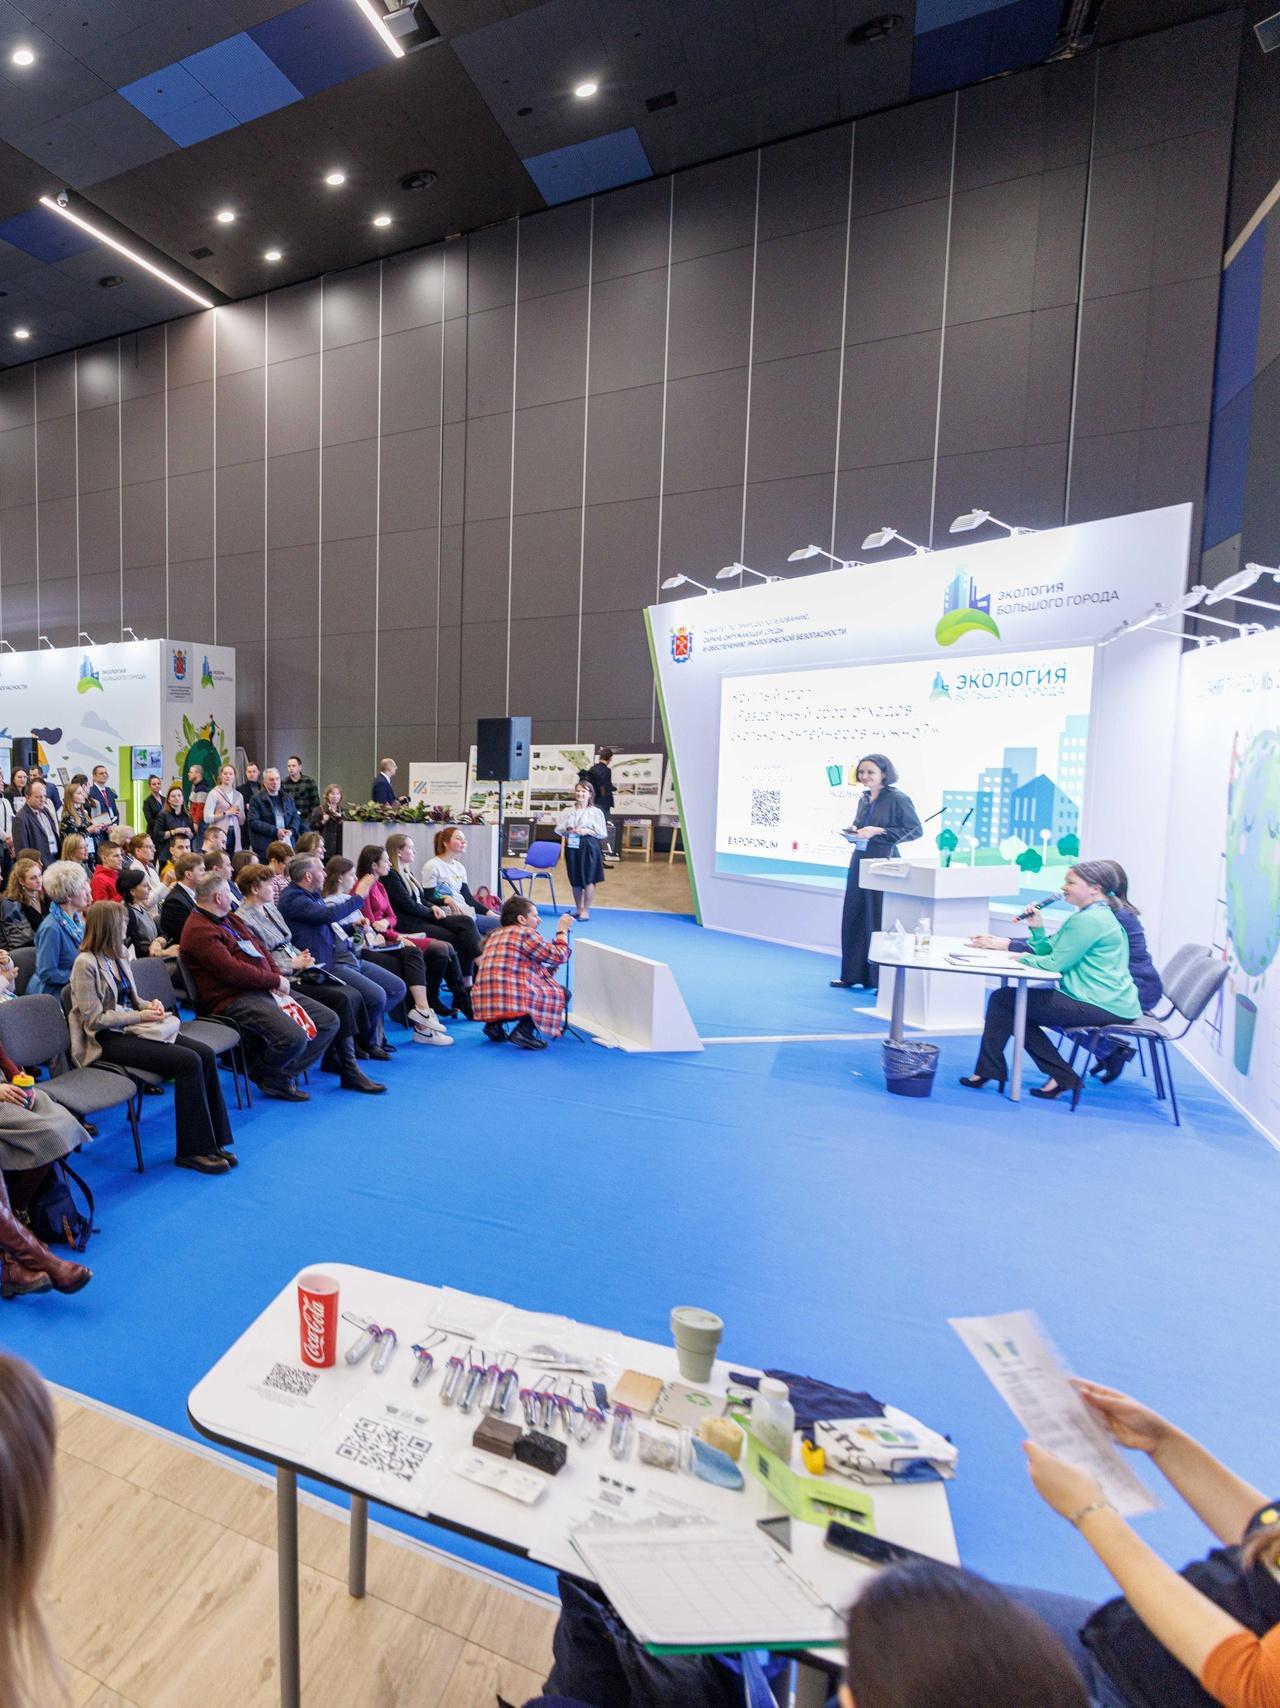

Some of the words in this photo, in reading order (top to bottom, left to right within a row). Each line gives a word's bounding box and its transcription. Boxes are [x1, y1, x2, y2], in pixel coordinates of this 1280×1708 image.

[996, 597, 1064, 615] БОЛЬШОГО
[1066, 590, 1120, 607] ГОРОДА
[997, 582, 1064, 601] ЭКОЛОГИЯ
[956, 668, 1067, 690] ЭКОЛОГИЯ
